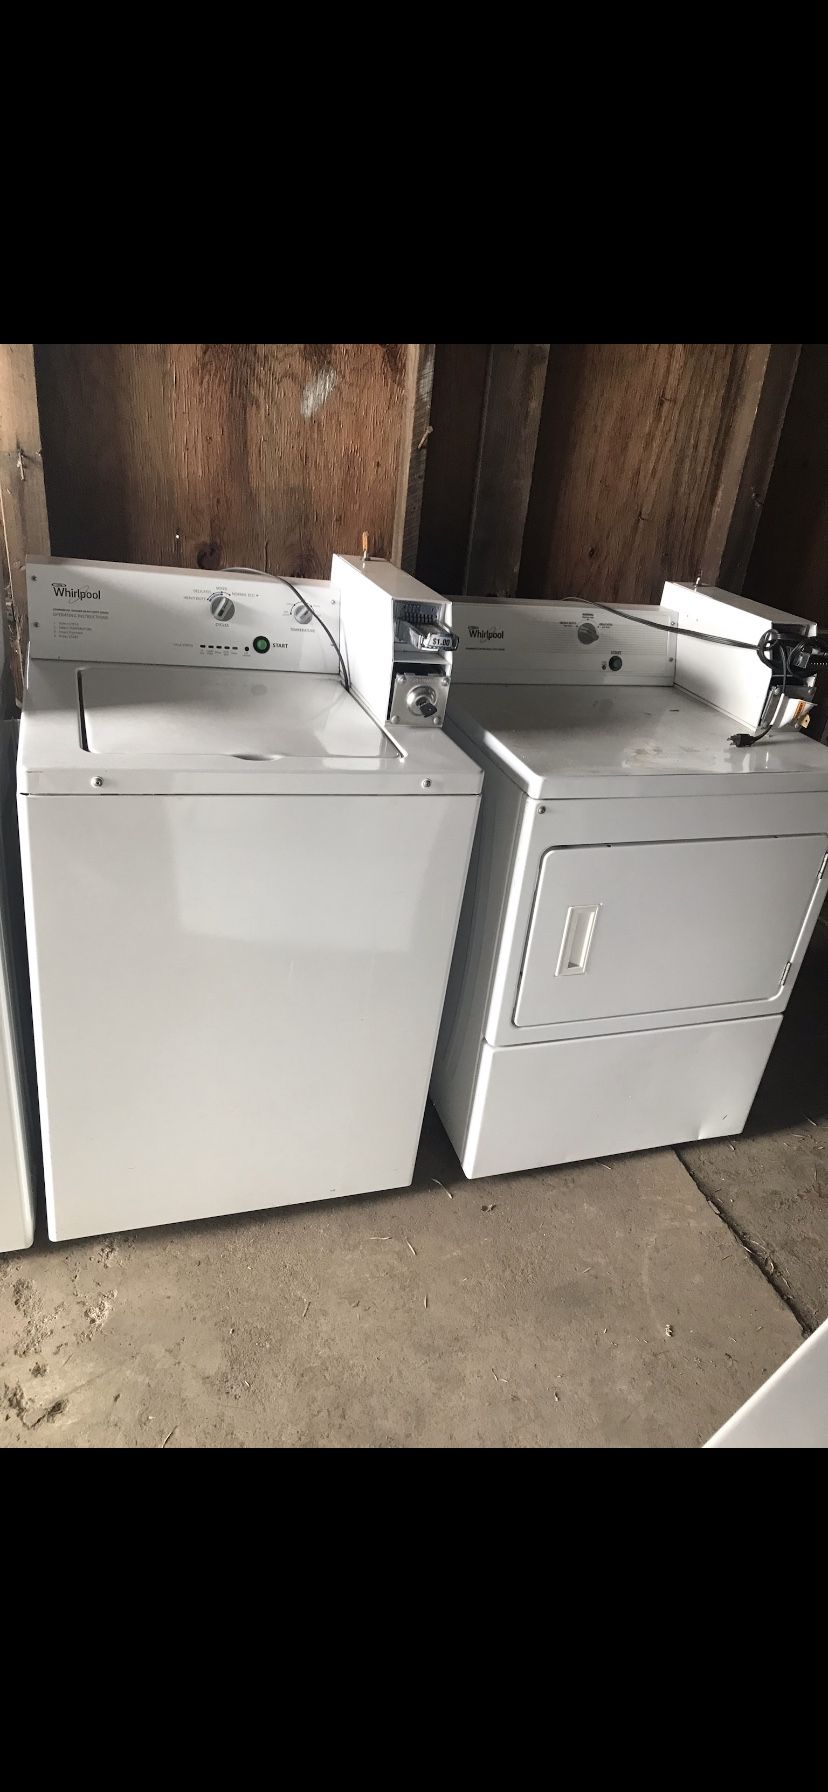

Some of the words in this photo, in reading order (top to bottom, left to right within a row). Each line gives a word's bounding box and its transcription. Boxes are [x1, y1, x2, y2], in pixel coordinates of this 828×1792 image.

[53, 586, 101, 600] Whirlpool
[469, 629, 504, 641] Whirlpool
[433, 638, 450, 646] $1.00
